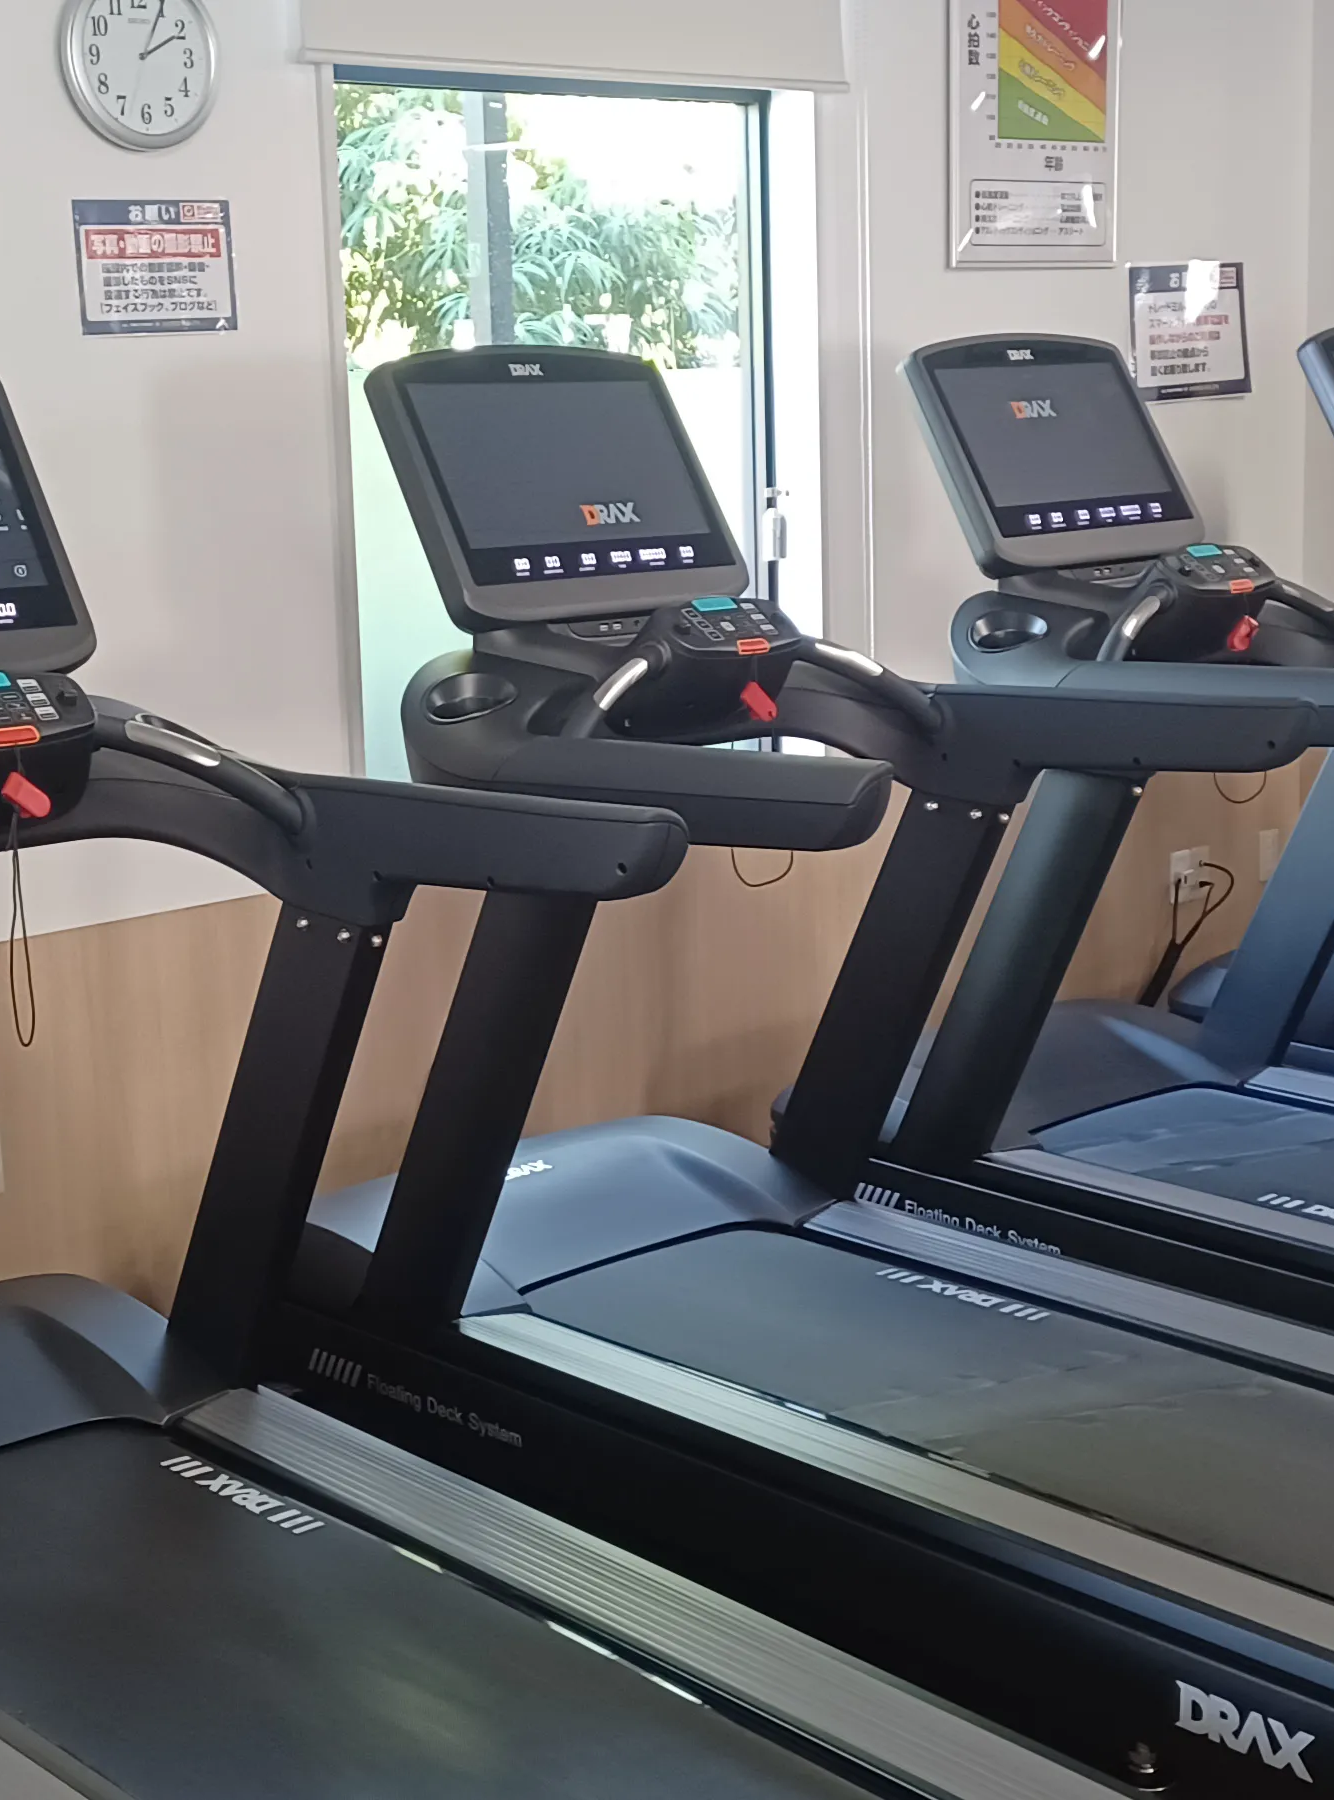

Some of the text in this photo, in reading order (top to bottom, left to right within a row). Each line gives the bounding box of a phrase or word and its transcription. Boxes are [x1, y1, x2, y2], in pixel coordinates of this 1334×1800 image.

[91, 15, 108, 36] 10
[174, 19, 186, 40] 2
[89, 44, 101, 65] 9
[183, 48, 194, 69] 3
[97, 73, 109, 94] 8
[178, 77, 190, 97] 4
[116, 95, 127, 116] 7
[141, 103, 152, 124] 6
[164, 97, 175, 117] 5
[508, 363, 544, 376] DRAX
[1010, 399, 1057, 419] DRAX
[579, 502, 641, 526] DRAX
[905, 1199, 1061, 1255] Floating Deck System
[367, 1373, 522, 1448] Floating Deck System
[194, 1473, 285, 1514] DRAX
[1175, 1680, 1315, 1783] DRAX
